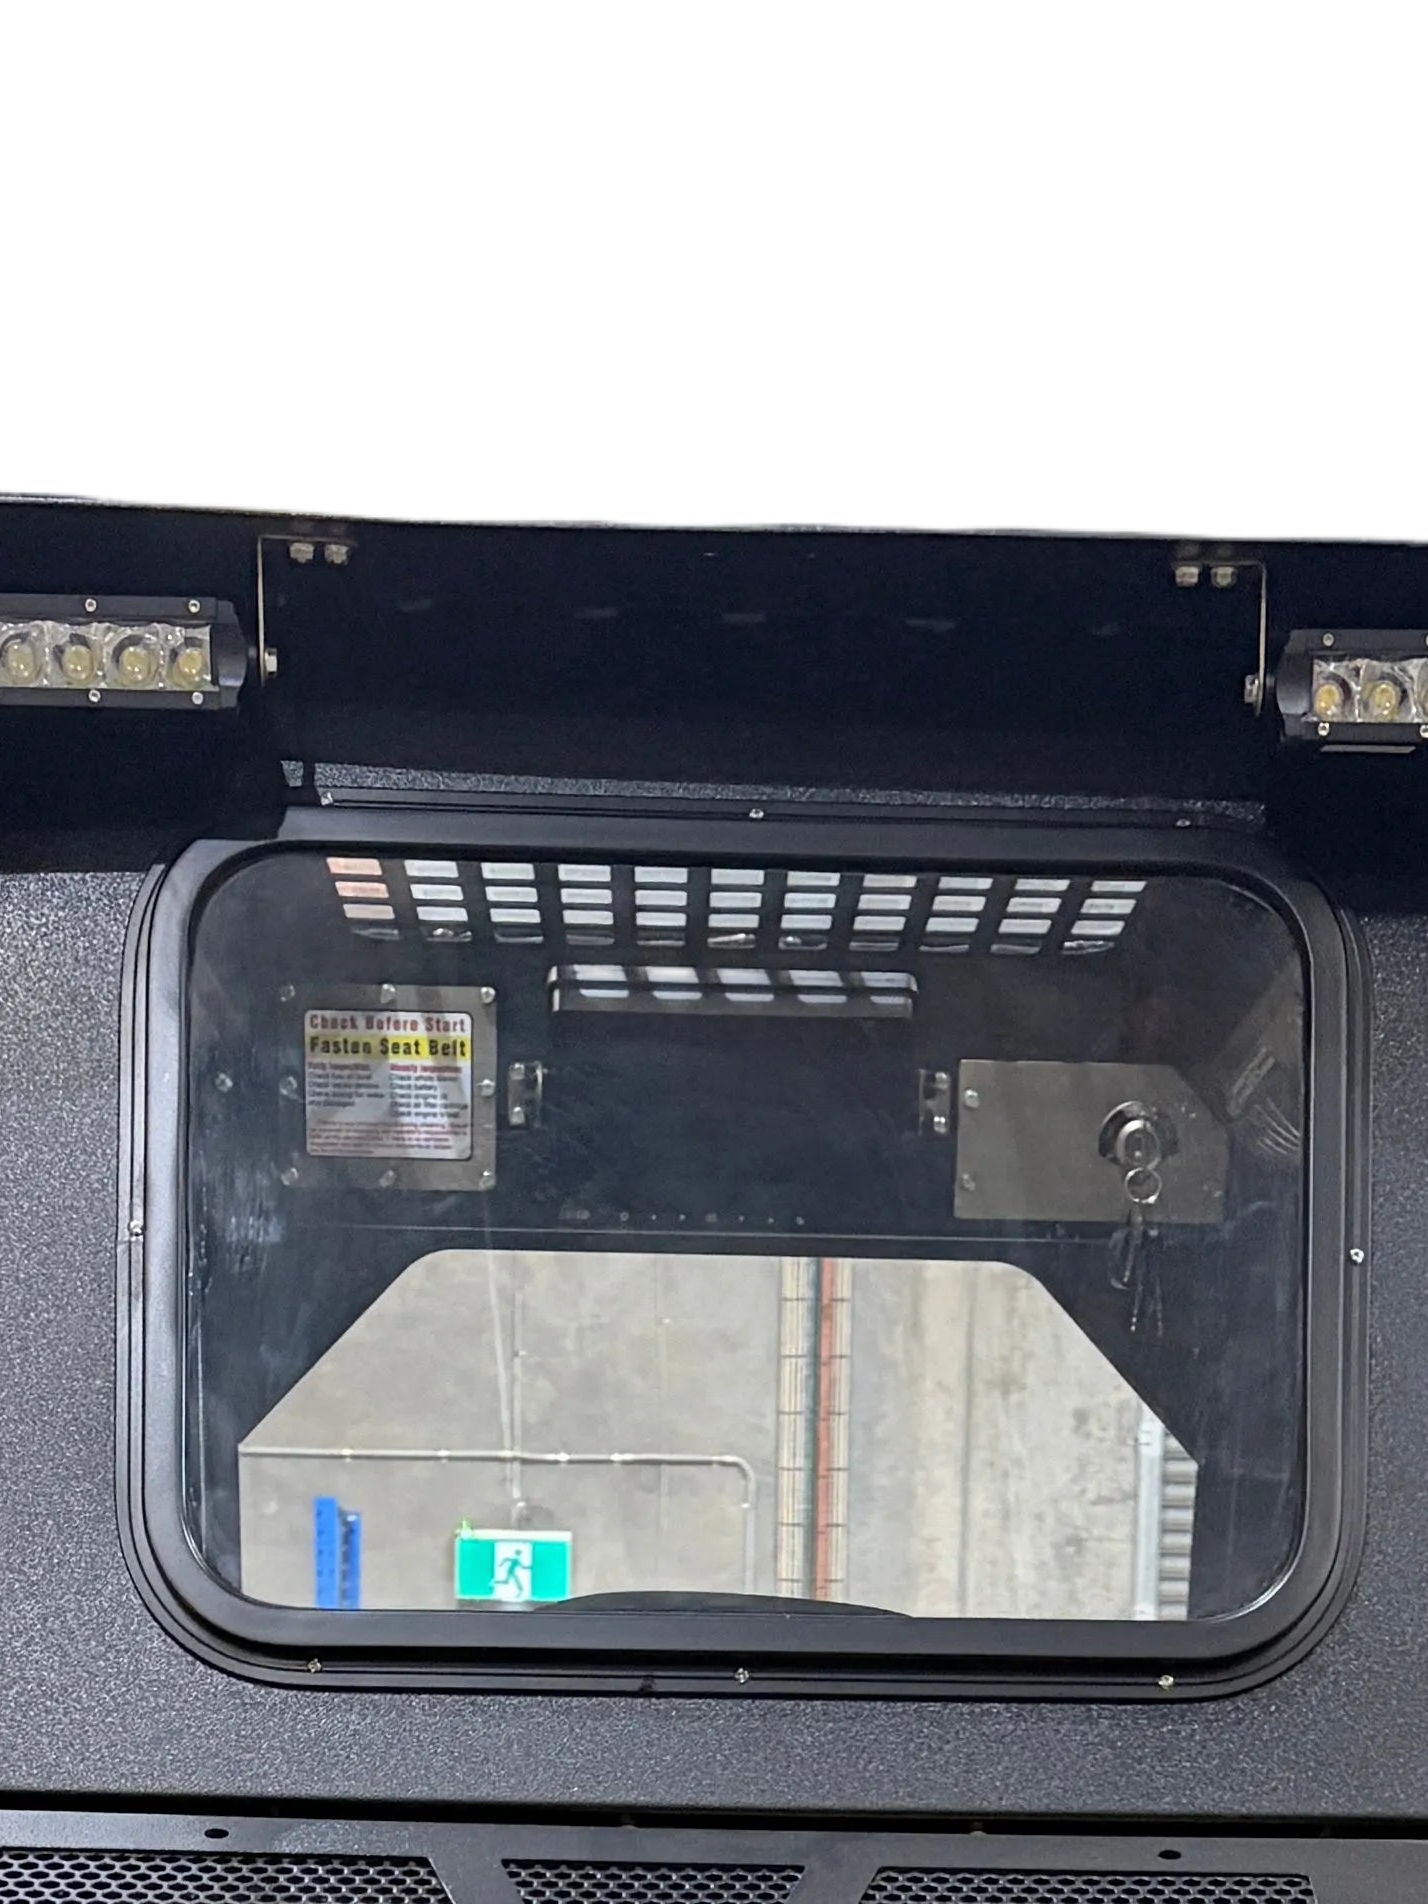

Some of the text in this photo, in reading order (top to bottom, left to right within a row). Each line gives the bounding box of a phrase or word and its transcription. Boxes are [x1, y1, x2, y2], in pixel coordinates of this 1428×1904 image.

[310, 1013, 466, 1033] Check Before Start
[310, 1035, 467, 1057] Fasten Seat Belt
